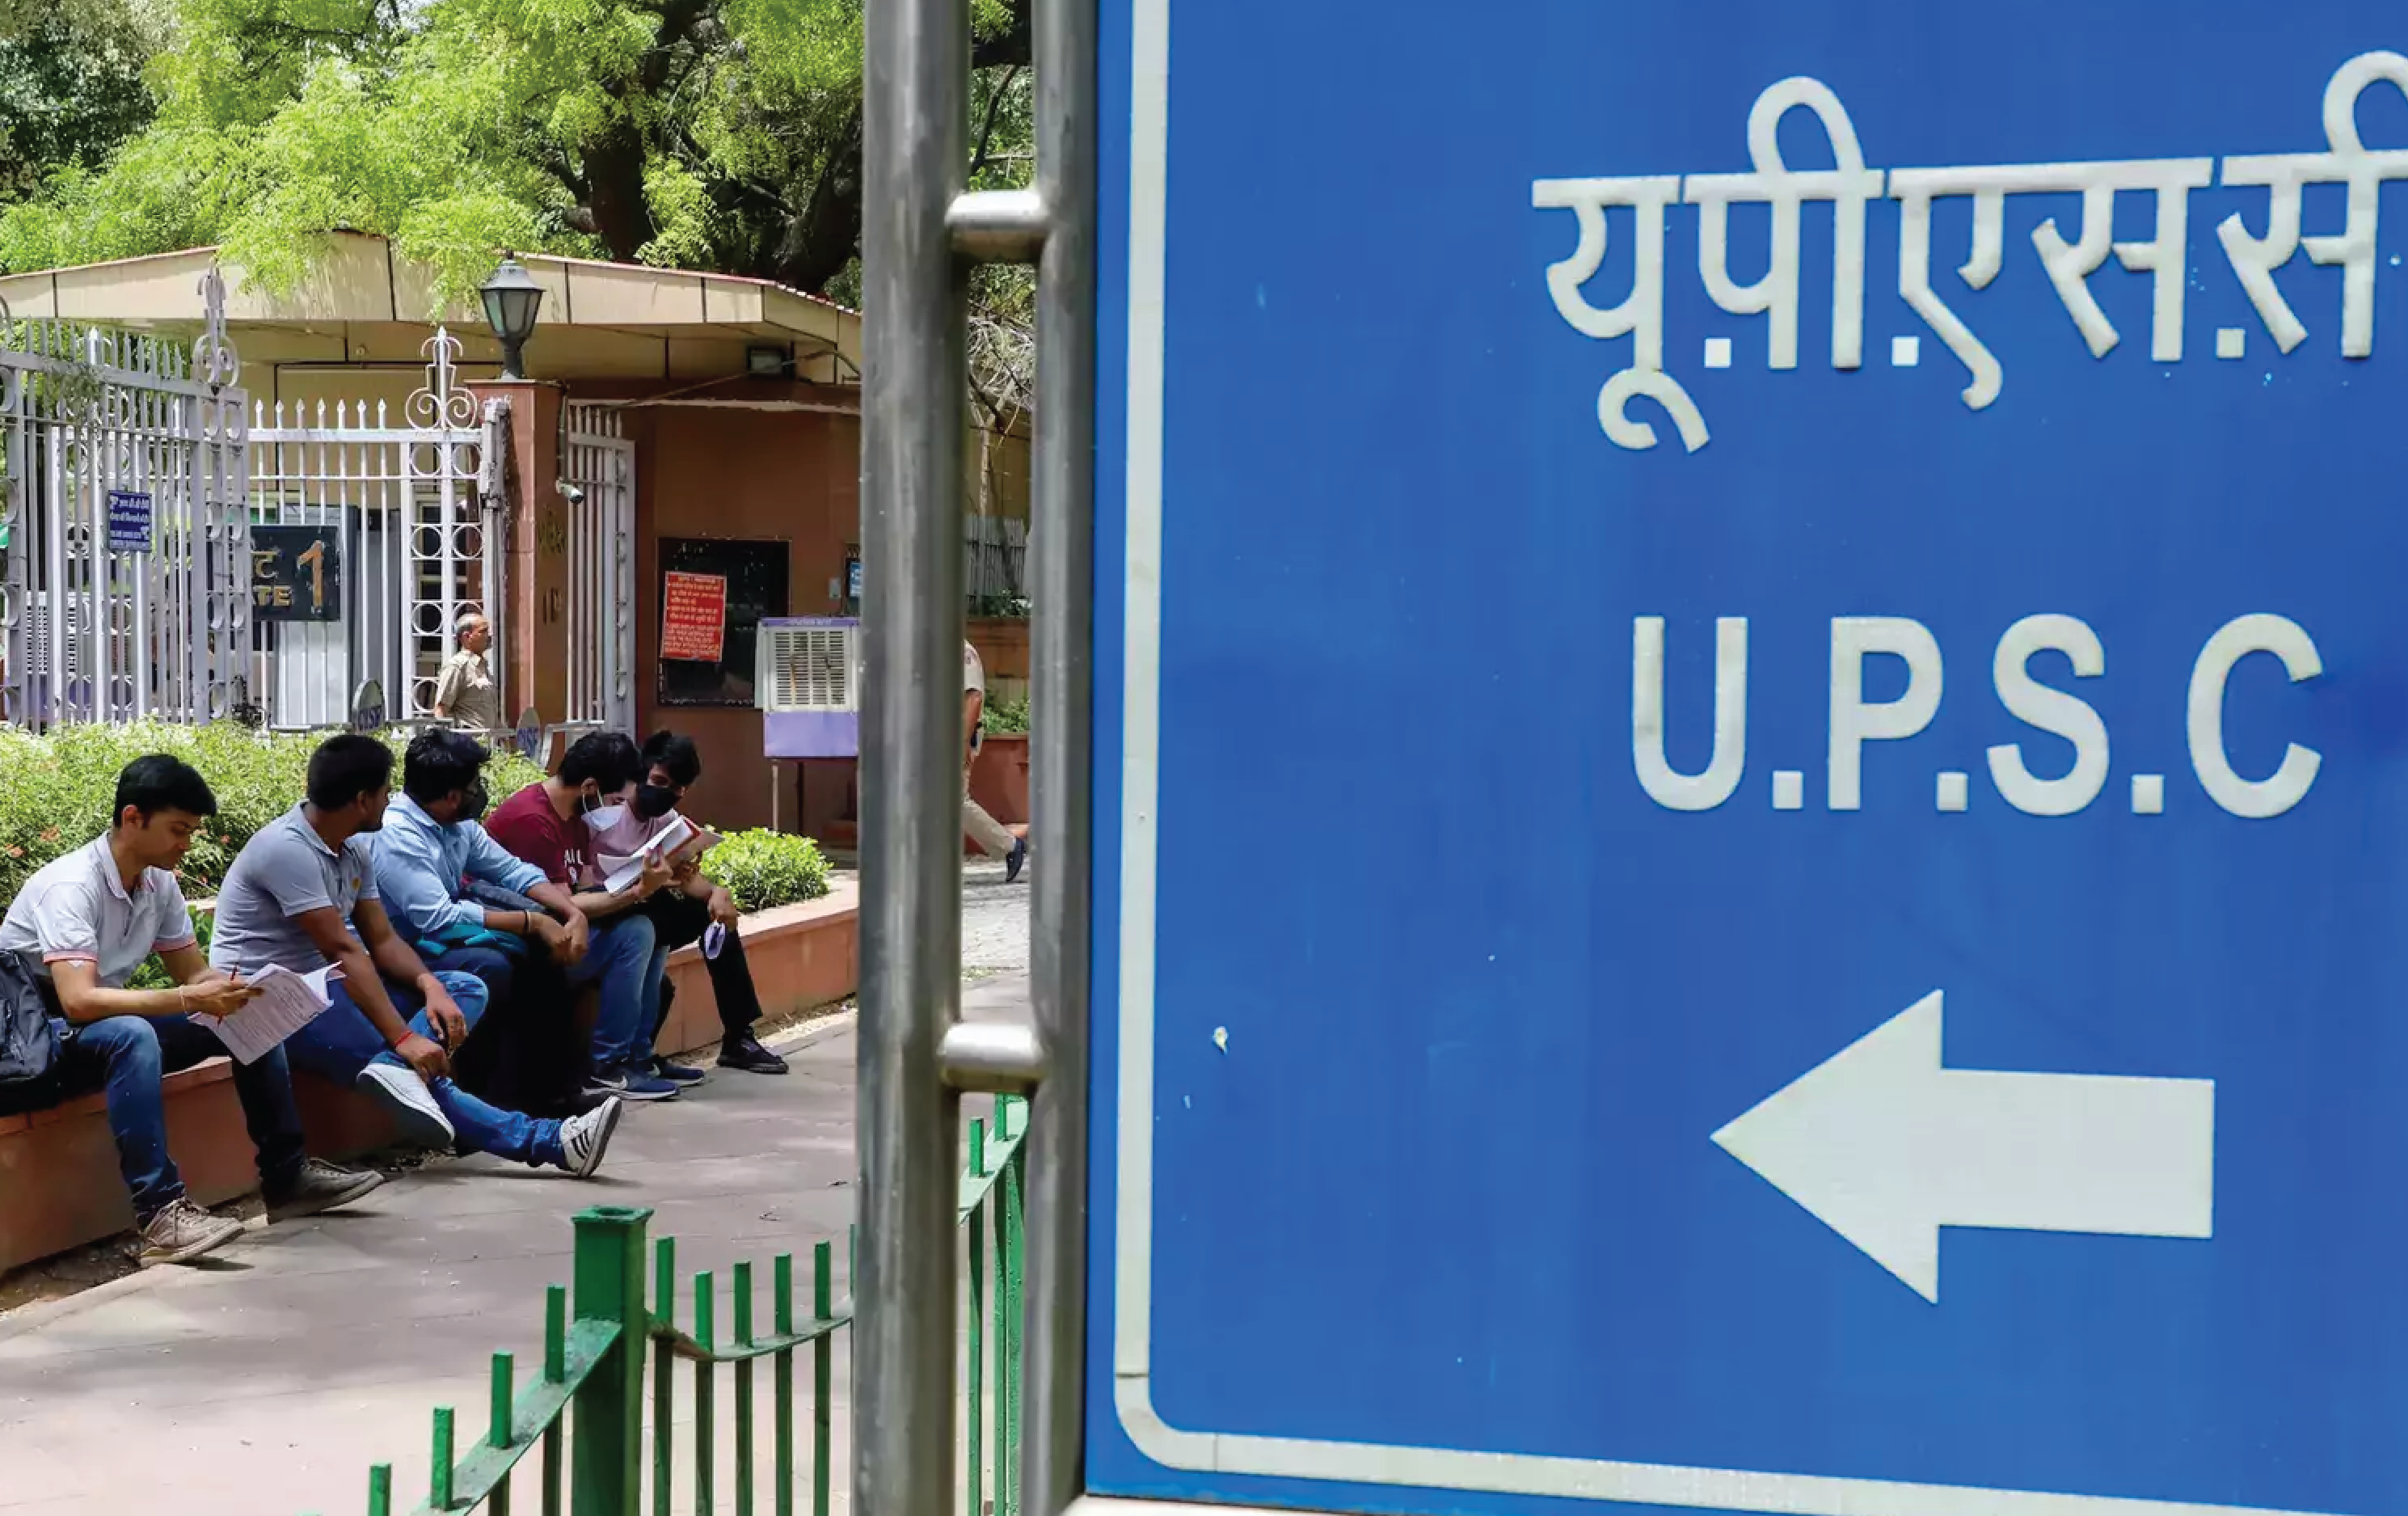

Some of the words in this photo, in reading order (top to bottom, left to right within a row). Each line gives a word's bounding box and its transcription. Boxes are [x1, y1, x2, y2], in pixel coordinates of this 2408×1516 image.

[251, 585, 292, 606] TE
[296, 539, 325, 610] 1
[1634, 615, 2320, 817] U.P.S.C
